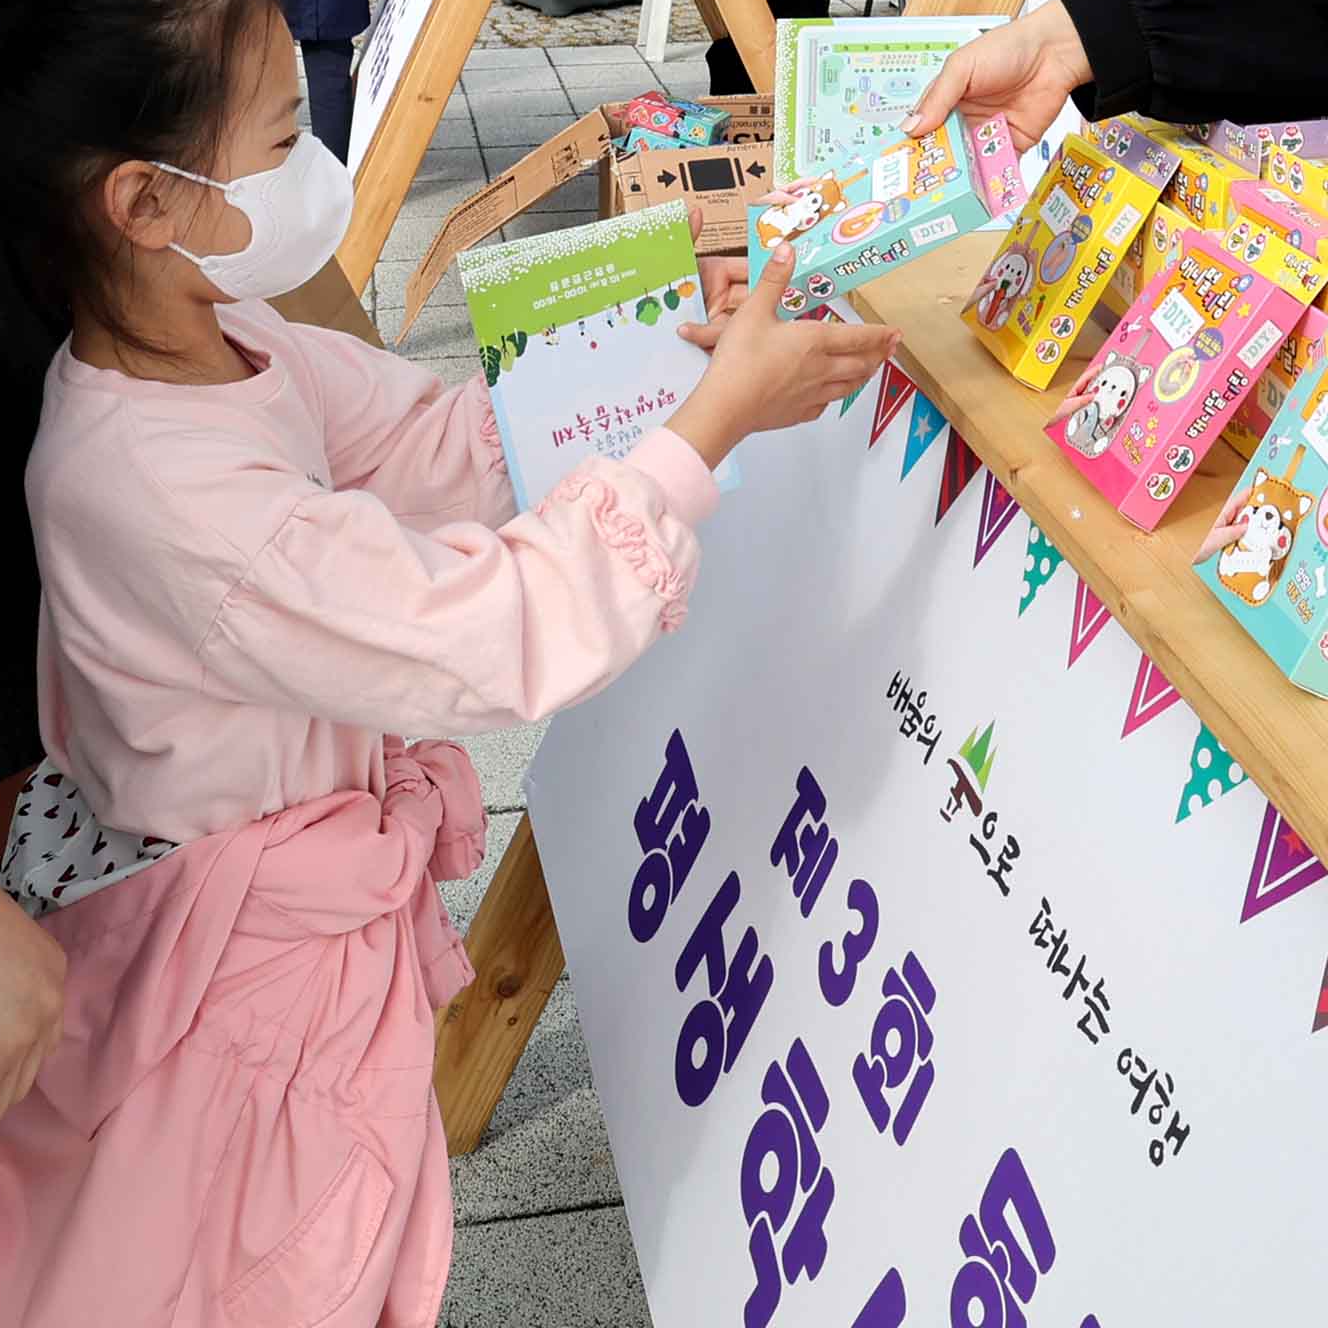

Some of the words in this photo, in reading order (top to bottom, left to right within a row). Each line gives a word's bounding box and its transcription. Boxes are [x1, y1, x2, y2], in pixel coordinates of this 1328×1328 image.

[920, 220, 947, 240] DIY
[1047, 193, 1071, 228] DIY
[1111, 208, 1137, 243] DIY
[1063, 249, 1116, 310] 애니멀키링
[1178, 255, 1235, 321] 애니멀키링
[1160, 298, 1194, 337] DIY
[1245, 329, 1276, 362] DIY
[552, 387, 678, 448] 평생학습축제
[1185, 369, 1251, 439] 애니멀키링
[886, 670, 944, 766] 배움의
[1028, 897, 1114, 1046] 떠나는
[1116, 1046, 1192, 1168] 여행
[627, 726, 908, 1328] 평생학
